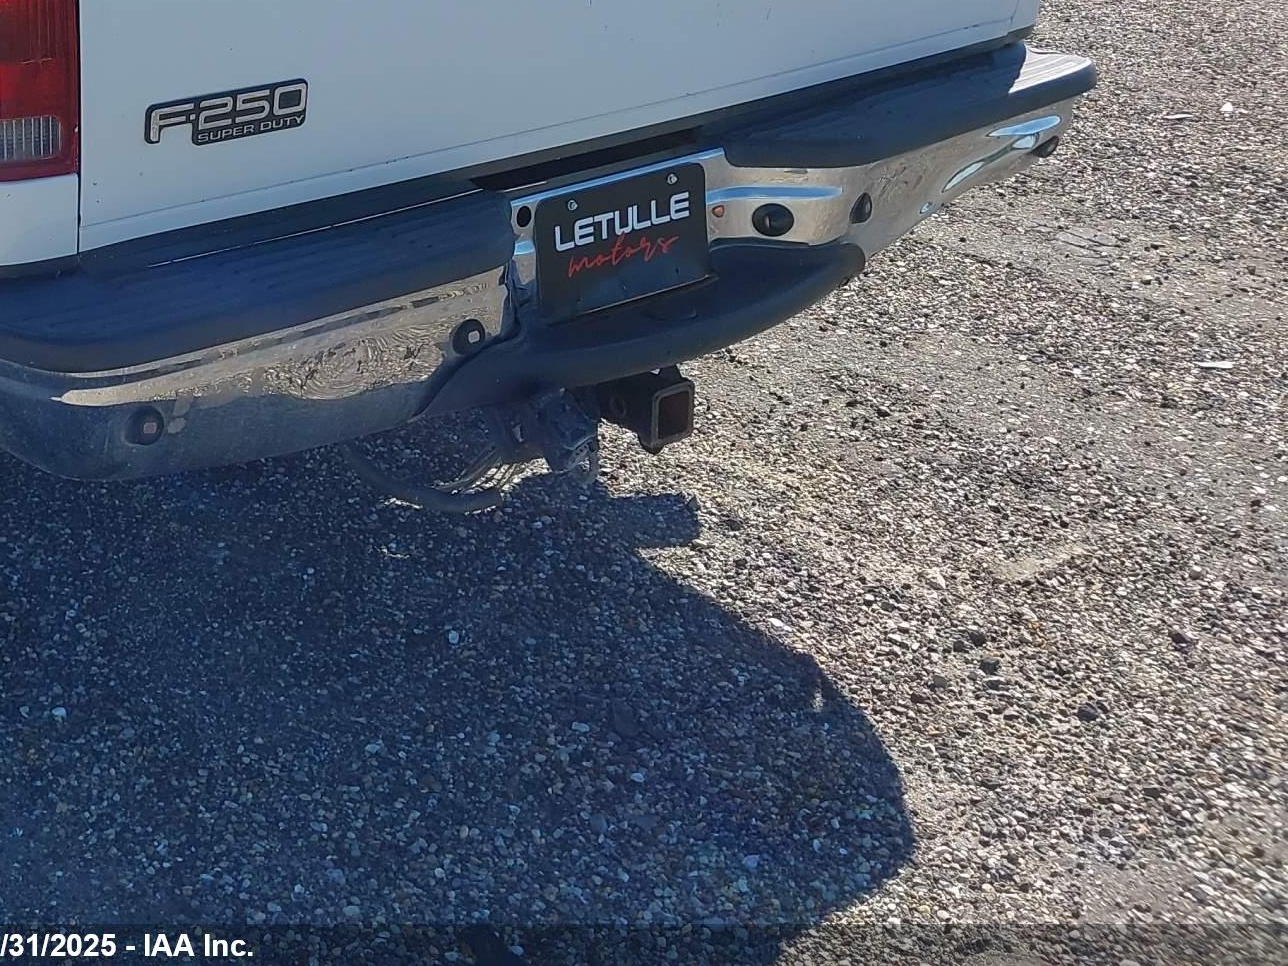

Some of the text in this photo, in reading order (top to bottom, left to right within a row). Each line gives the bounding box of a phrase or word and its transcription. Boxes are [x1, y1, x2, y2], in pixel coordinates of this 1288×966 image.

[197, 114, 305, 143] SUPER DUTY
[554, 191, 690, 252] LETULLE
[568, 235, 680, 279] motors
